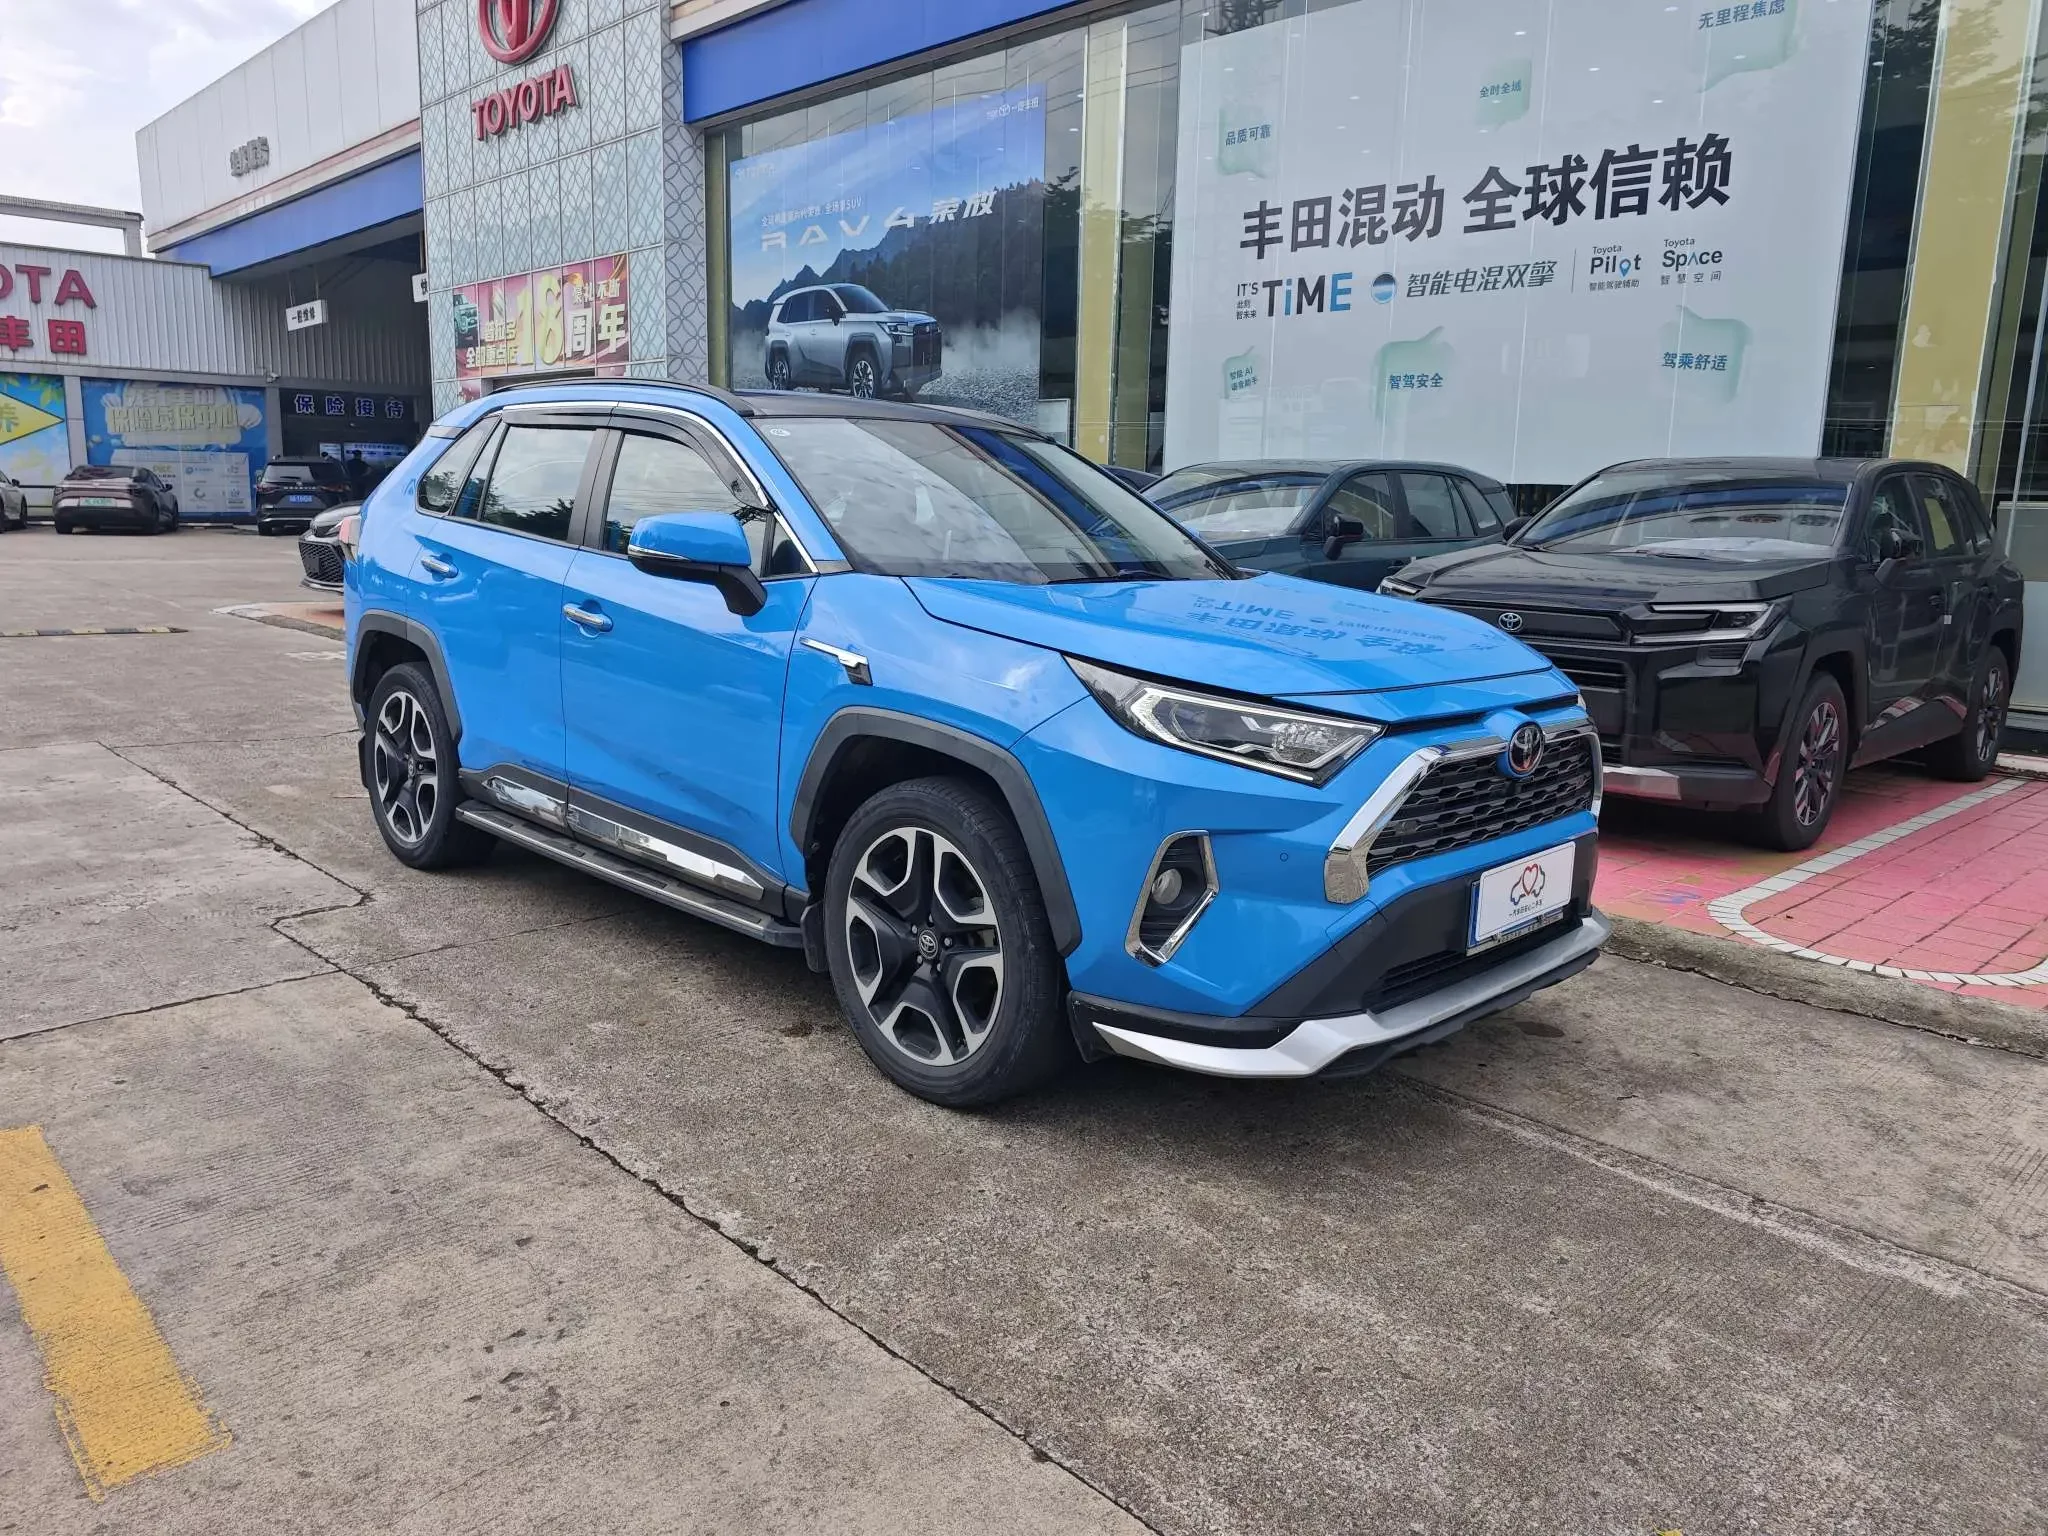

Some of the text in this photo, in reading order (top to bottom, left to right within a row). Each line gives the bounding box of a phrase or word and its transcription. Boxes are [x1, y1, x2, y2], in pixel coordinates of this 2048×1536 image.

[1698, 0, 1786, 30] 无里程焦虑
[1479, 79, 1522, 99] 全时全域
[472, 64, 579, 141] TOYOTA
[1225, 124, 1271, 147] 品质可靠
[1239, 132, 1732, 260] 丰田混动 全球信赖
[761, 206, 916, 252] RAV4
[929, 190, 998, 225] 荣放
[1593, 244, 1622, 256] Toyota
[1664, 237, 1696, 249] Toyota
[1406, 260, 1558, 298] 智能电混双擎
[1661, 271, 1722, 285] 智慧空间
[1237, 272, 1353, 318] IT'S TiME
[0, 316, 87, 355] 丰田
[1662, 351, 1728, 372] 驾乘舒适
[1389, 372, 1444, 390] 智驾安全
[295, 394, 404, 418] 保险接待
